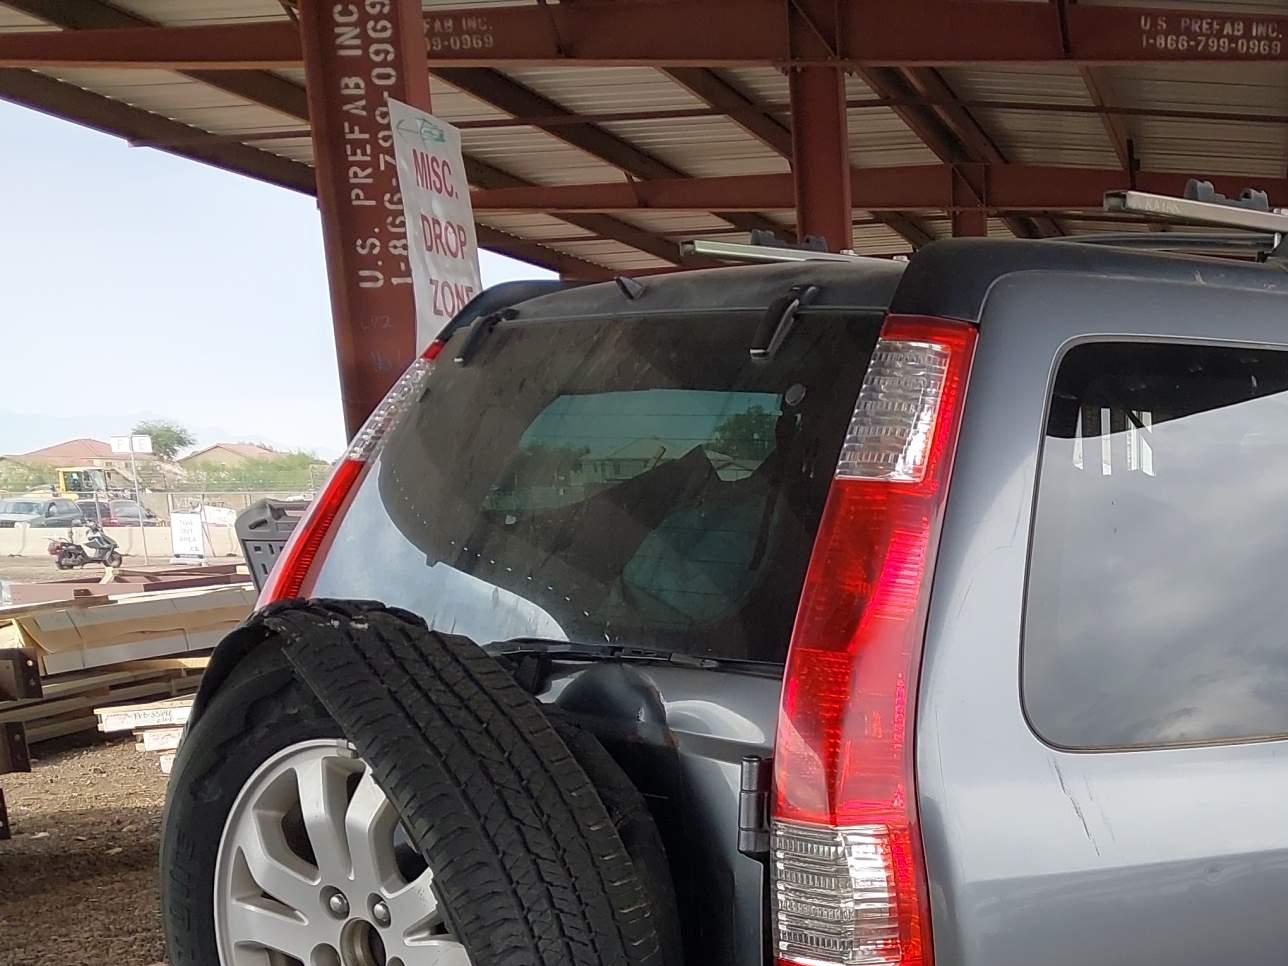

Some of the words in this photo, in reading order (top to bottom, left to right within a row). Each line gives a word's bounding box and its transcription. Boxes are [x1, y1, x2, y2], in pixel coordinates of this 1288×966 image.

[462, 16, 494, 31] INC.
[1141, 35, 1282, 55] 1-866-799-0969
[1180, 17, 1244, 36] PREFAB
[1252, 22, 1284, 39] INC.
[340, 76, 377, 206] PREFAB
[412, 148, 459, 200] MISC.
[355, 227, 385, 288] U.S.
[420, 213, 467, 260] DROP
